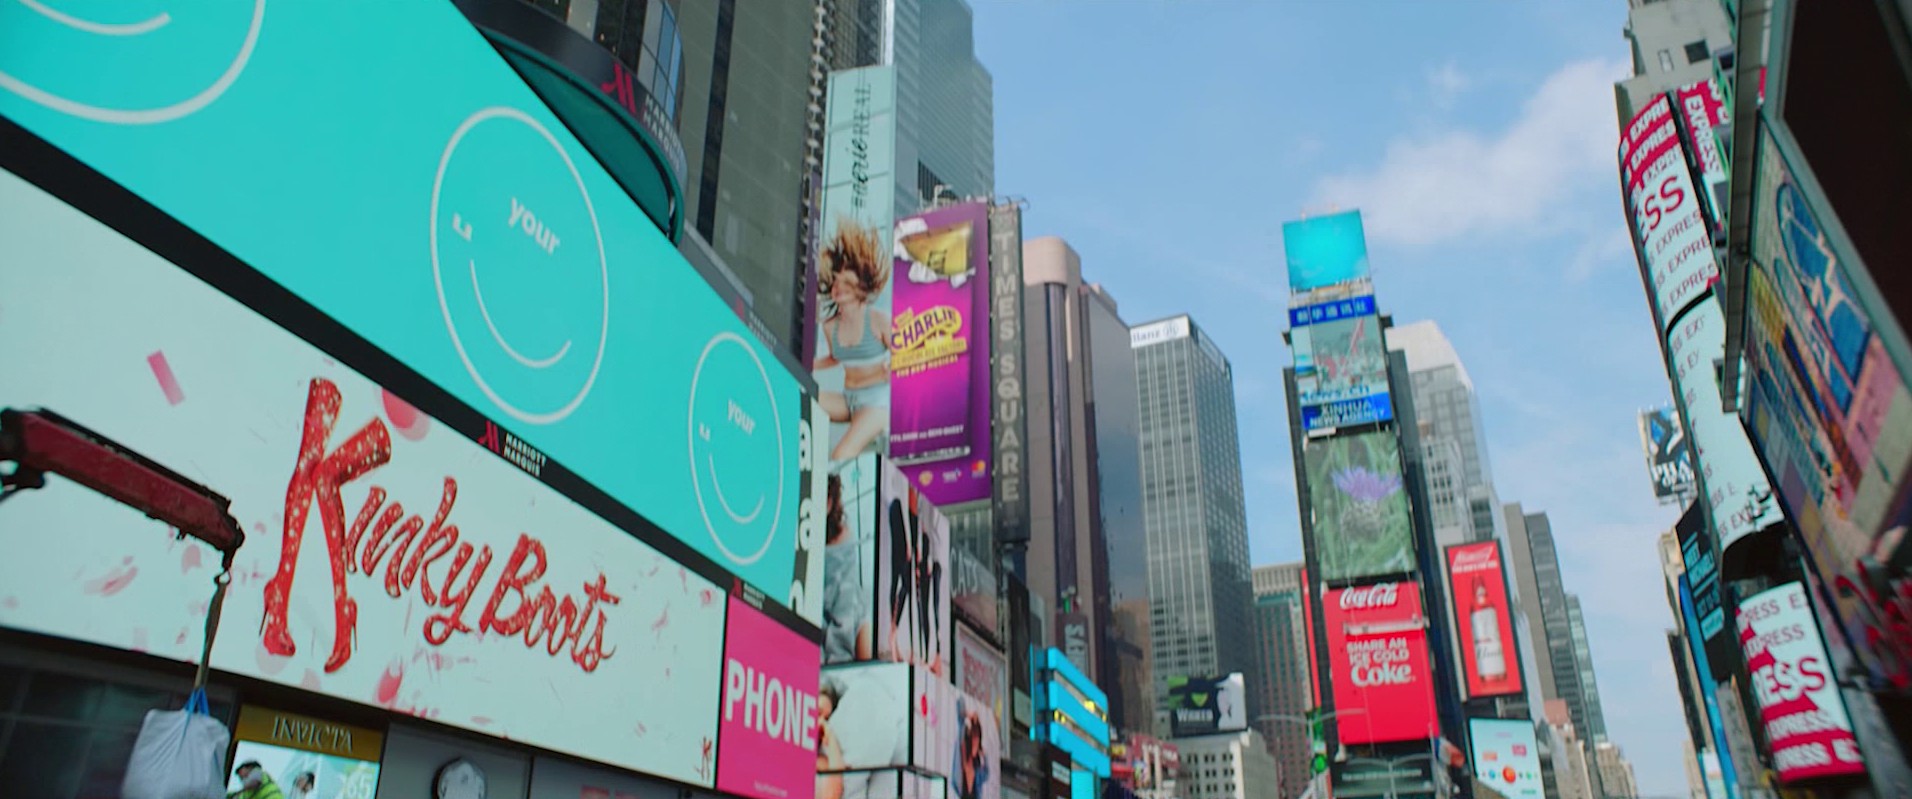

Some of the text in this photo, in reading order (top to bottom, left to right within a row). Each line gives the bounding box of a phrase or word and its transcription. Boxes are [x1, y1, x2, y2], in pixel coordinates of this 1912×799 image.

[1684, 95, 1721, 174] EXPRESS
[508, 196, 560, 256] your
[994, 231, 1018, 341] TIMES
[727, 398, 756, 436] your
[997, 353, 1020, 500] SQUARE
[1310, 413, 1341, 428] NEWS
[1321, 400, 1372, 418] XINHUA
[503, 445, 541, 477] MARQUIS
[506, 432, 546, 467] MARRIOTT
[260, 377, 621, 673] Kinky Boots
[950, 547, 978, 599] CATS
[1347, 637, 1408, 652] SHARE AN
[1350, 649, 1410, 669] ICE COLD
[1351, 661, 1412, 688] Coke
[725, 658, 818, 753] PHONE
[272, 715, 353, 753] INVICTA
